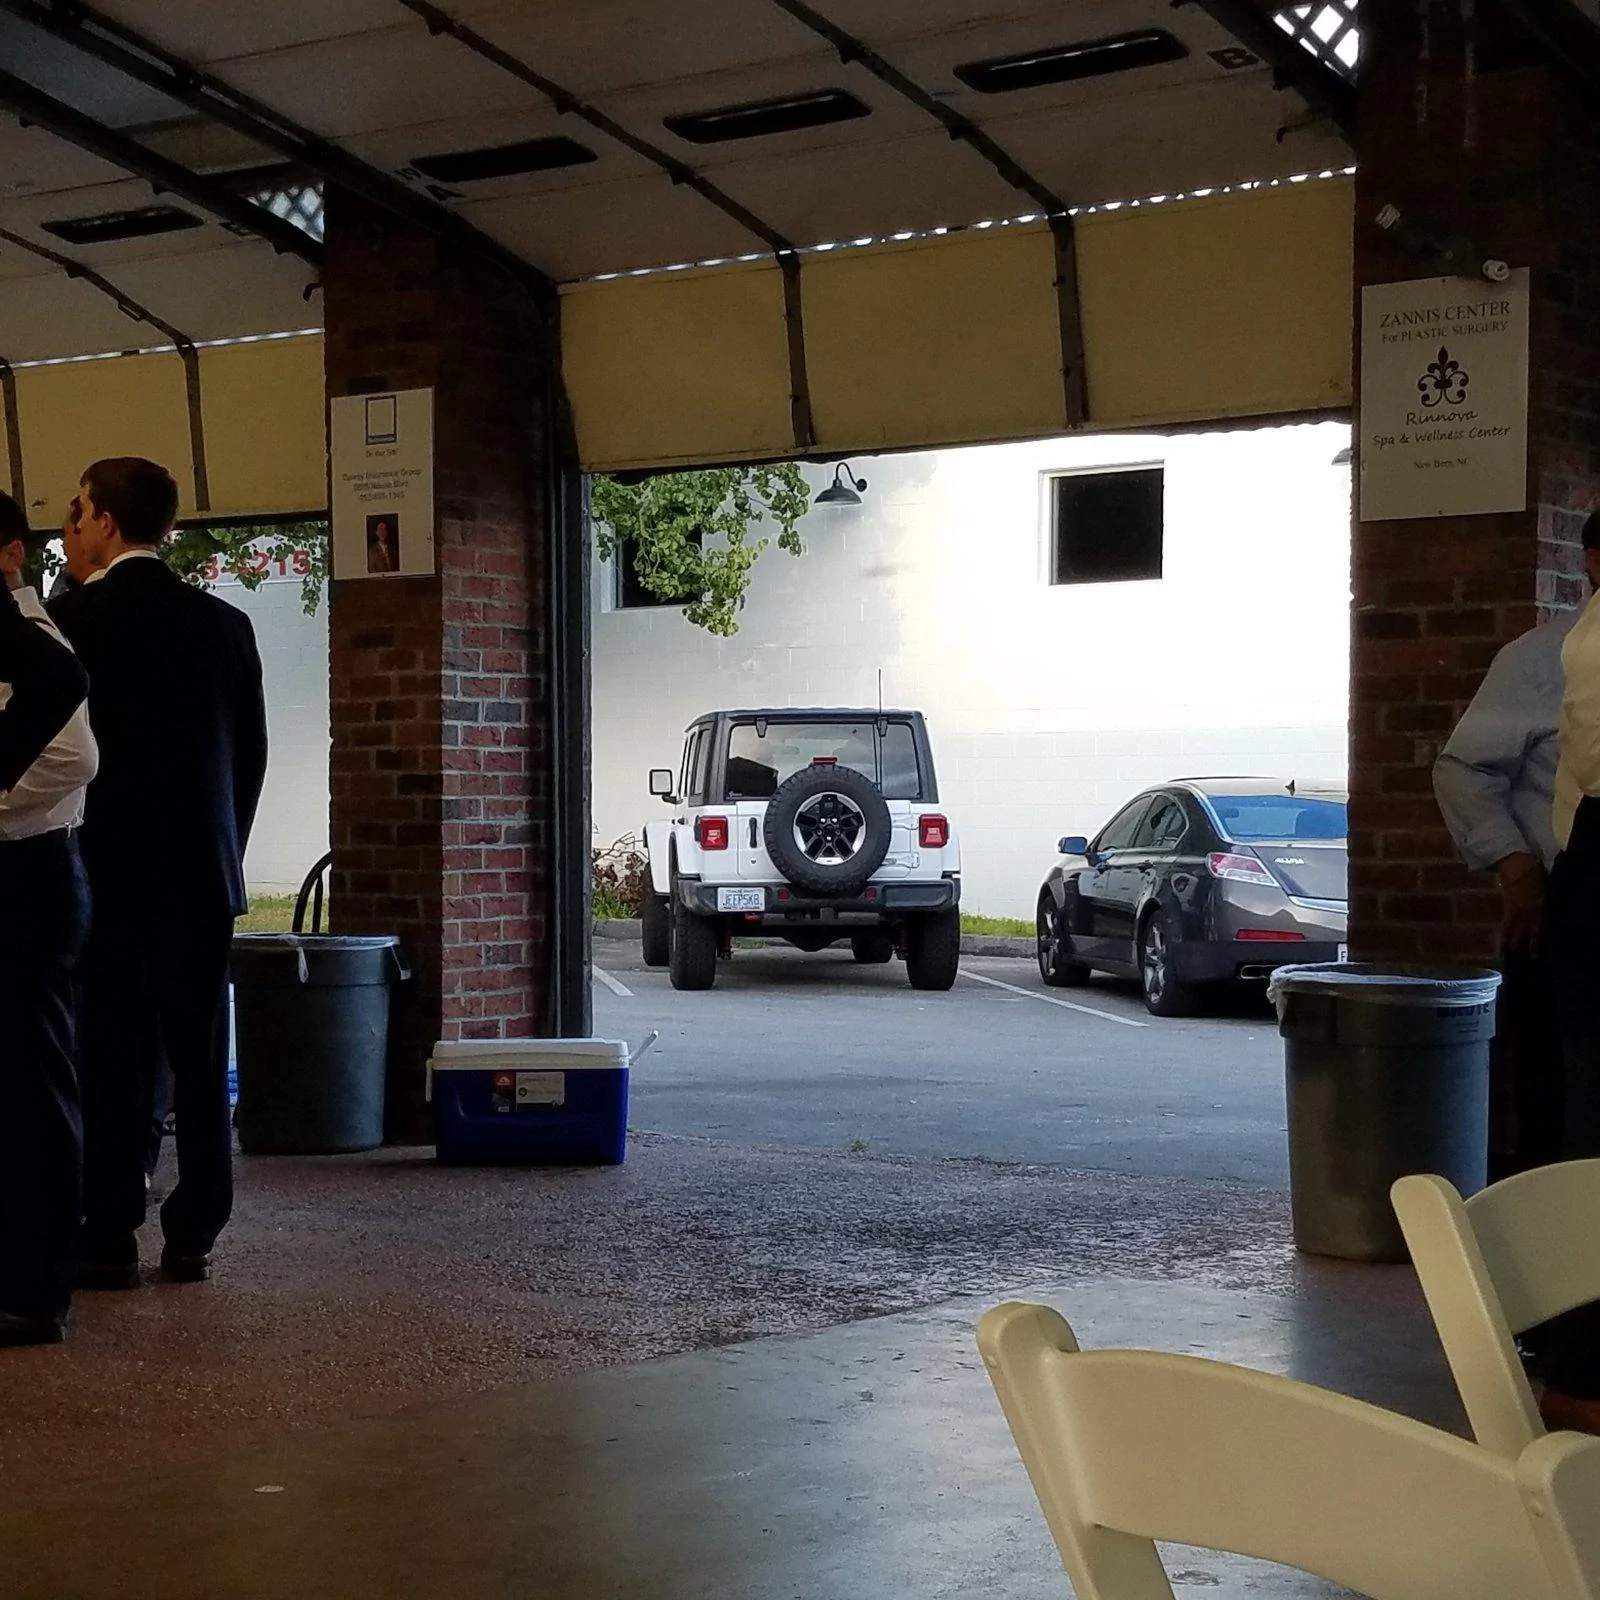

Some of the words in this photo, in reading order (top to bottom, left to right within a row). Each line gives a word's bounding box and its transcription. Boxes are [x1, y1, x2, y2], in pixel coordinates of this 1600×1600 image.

[1380, 307, 1440, 329] ZANNIS
[1444, 300, 1511, 321] CENTER
[1382, 332, 1399, 344] For
[1401, 326, 1448, 343] PLASTIC
[1451, 320, 1509, 336] SURGERY
[1405, 410, 1478, 426] Rinnova
[1372, 434, 1395, 449] Spa
[1399, 432, 1410, 444] &
[1415, 429, 1464, 443] Wellness
[1468, 425, 1513, 439] Center
[1274, 856, 1305, 865] ACURA
